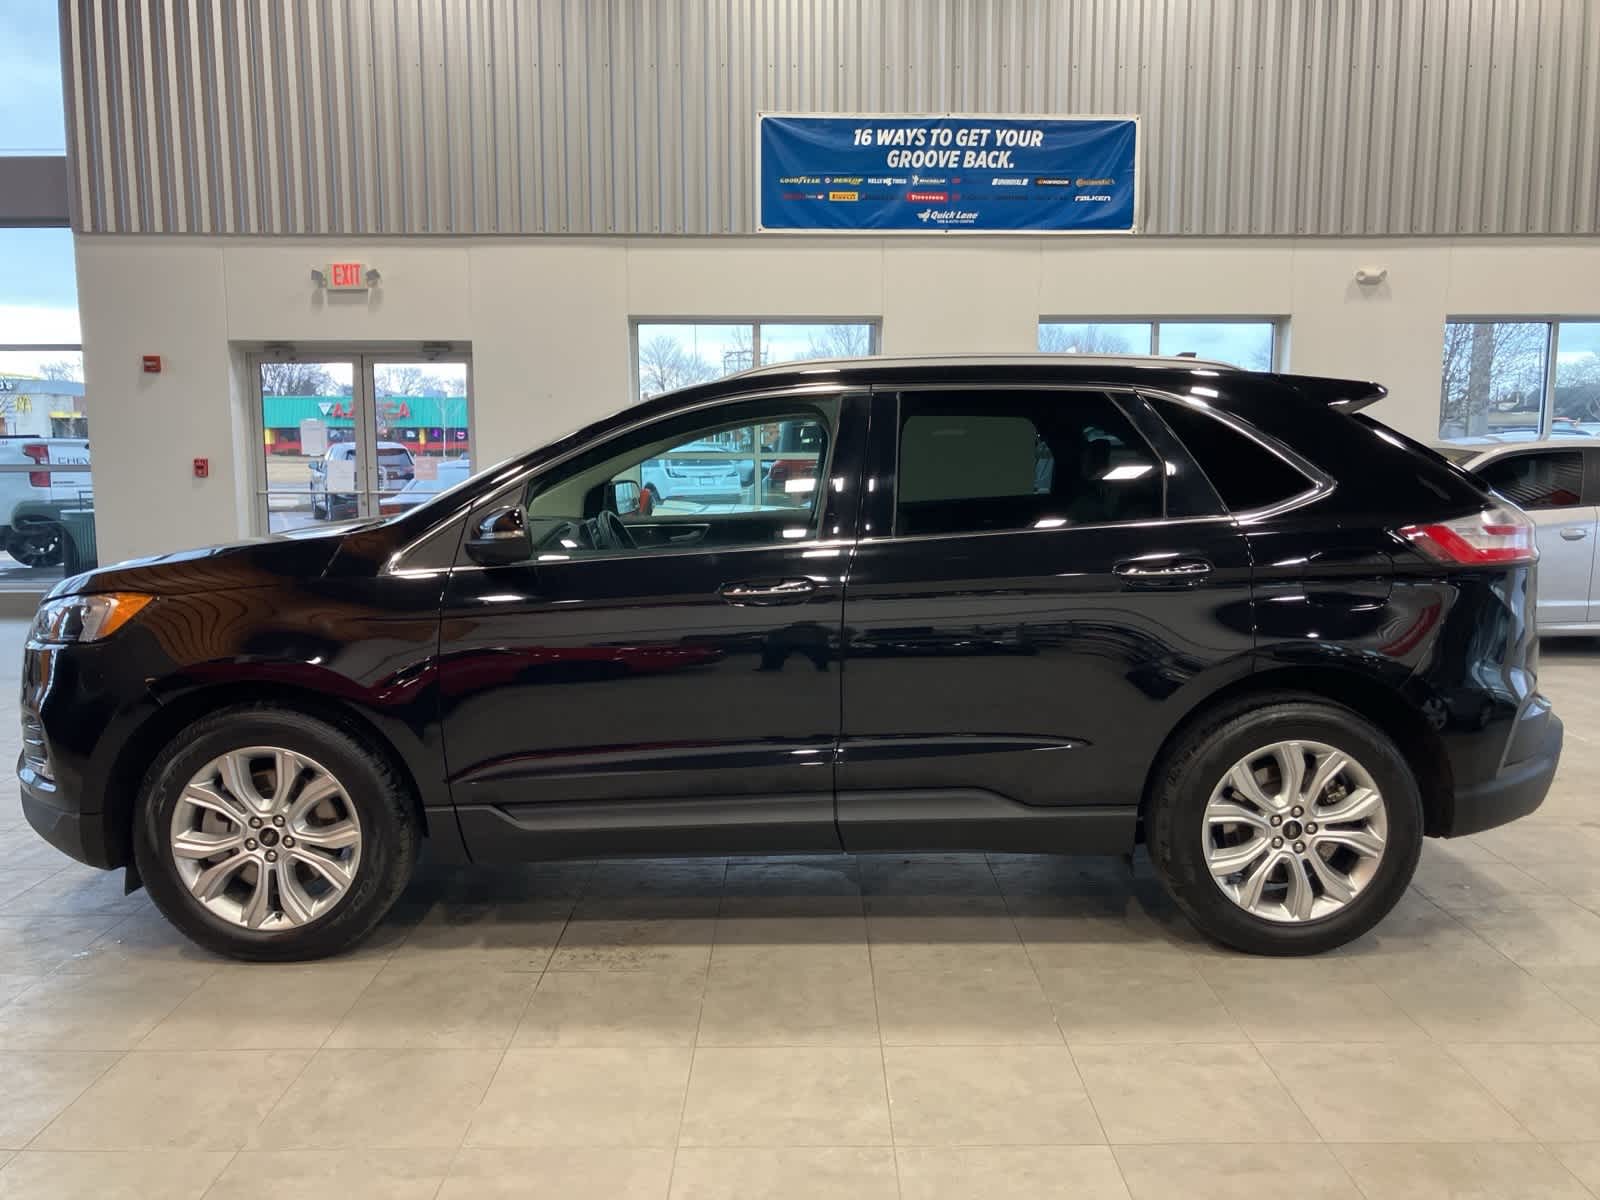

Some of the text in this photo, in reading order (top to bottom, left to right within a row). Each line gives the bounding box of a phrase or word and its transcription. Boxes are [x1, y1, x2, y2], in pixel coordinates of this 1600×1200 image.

[854, 128, 1044, 147] 16 WAYS TO GET YOUR
[887, 149, 1015, 169] GROOVE BACK.
[930, 209, 979, 220] Quick Lane
[333, 263, 361, 286] EXIT
